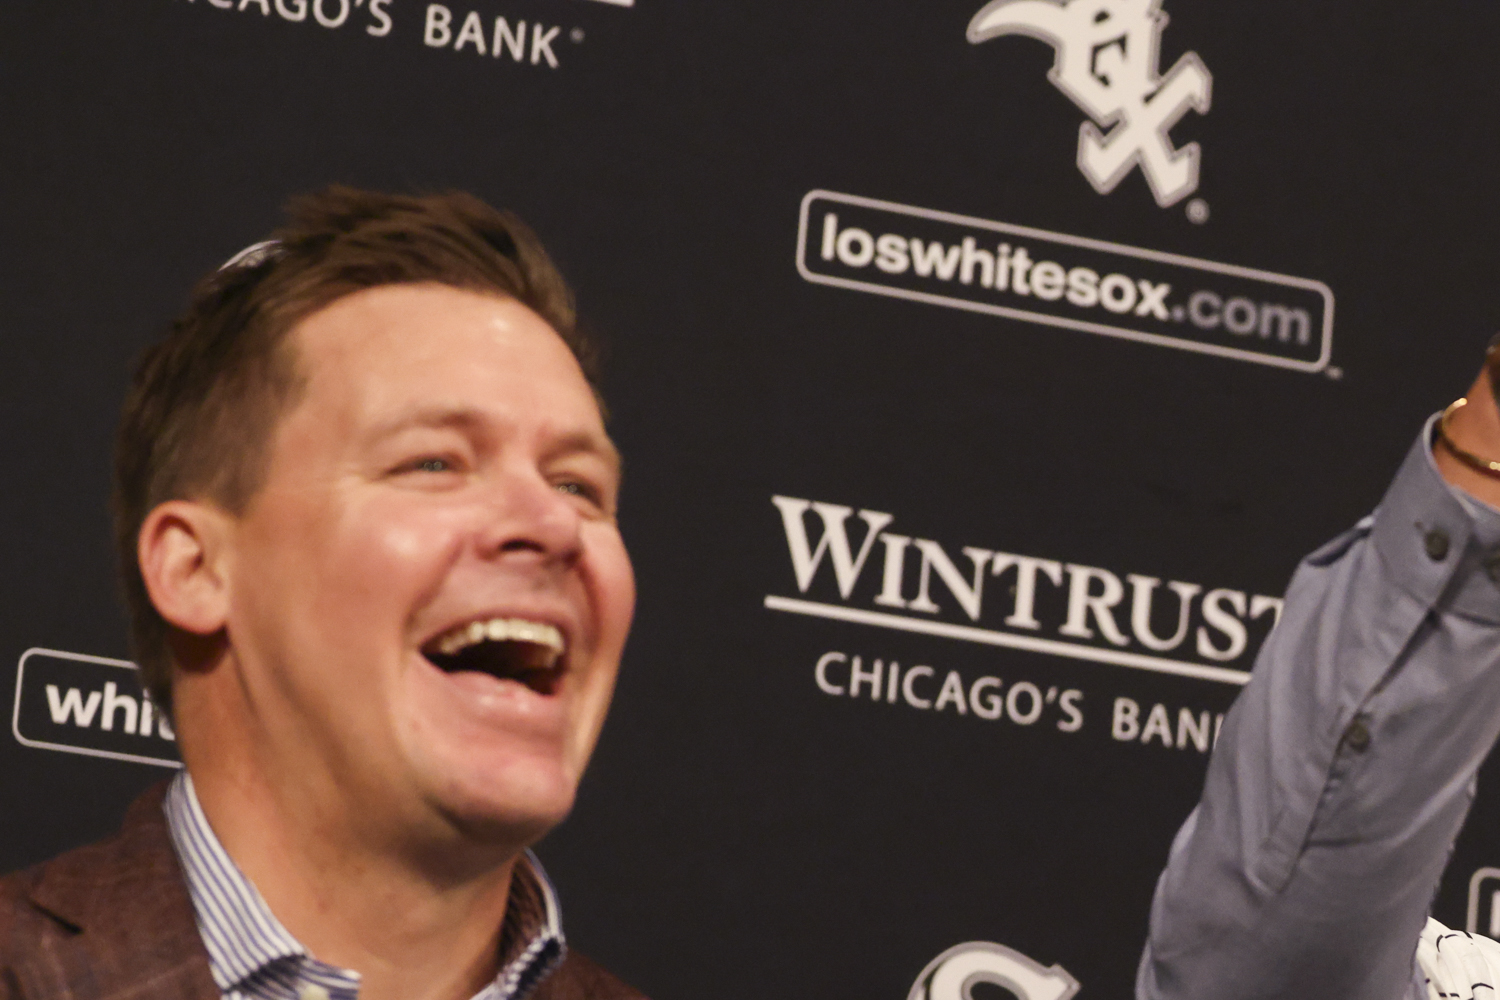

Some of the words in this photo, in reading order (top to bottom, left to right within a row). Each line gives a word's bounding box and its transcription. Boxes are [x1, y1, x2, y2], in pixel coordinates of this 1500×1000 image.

[424, 4, 562, 69] BANK
[820, 213, 1311, 346] loswhitesox.com
[814, 650, 1085, 734] CHICAGO'S
